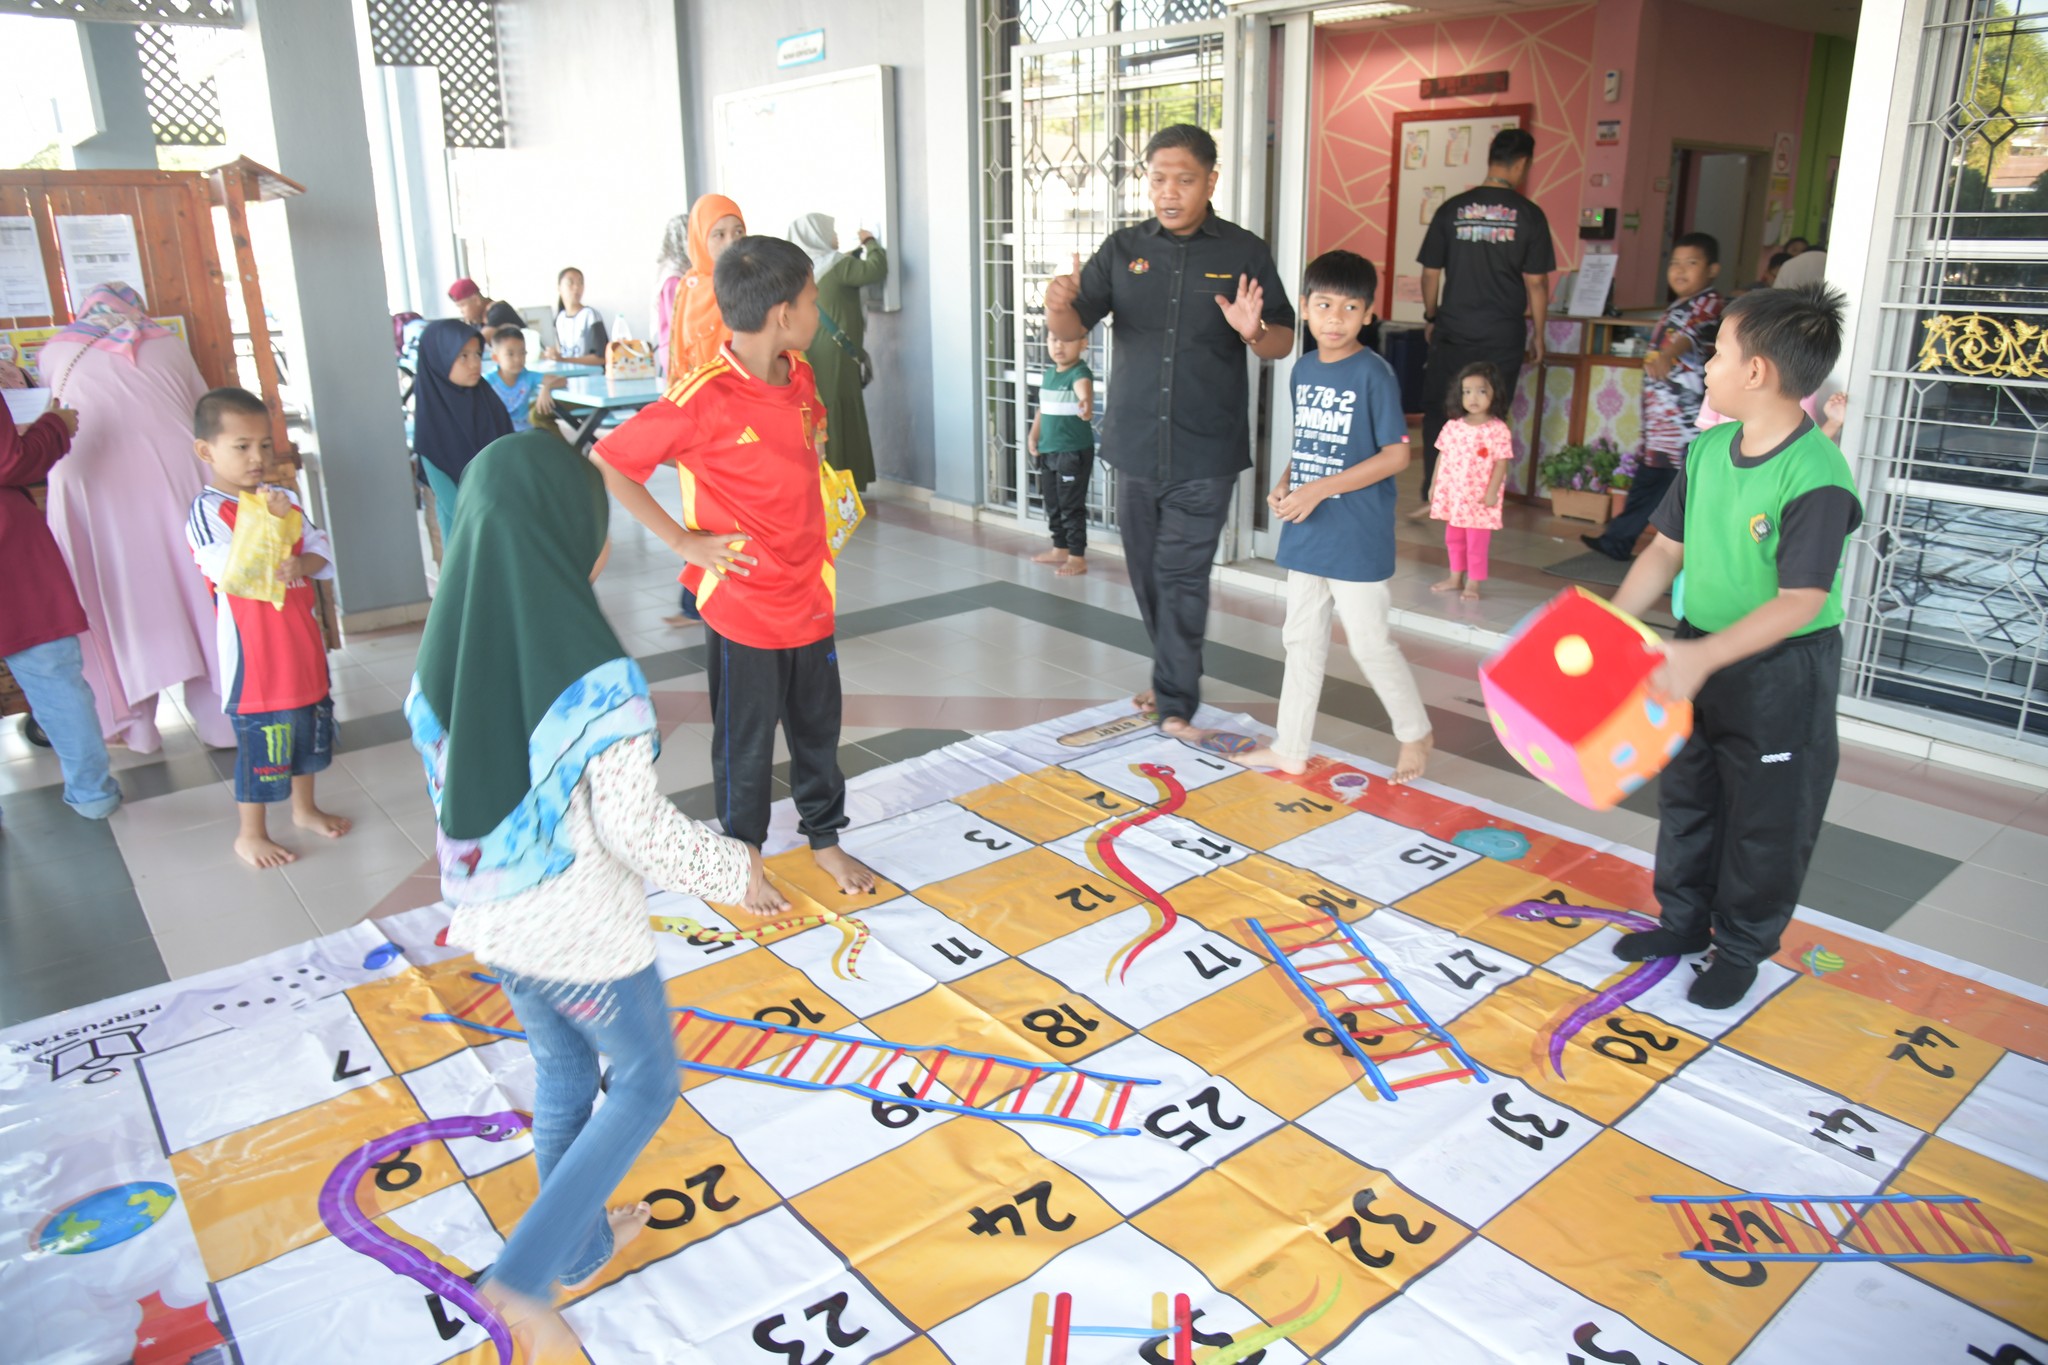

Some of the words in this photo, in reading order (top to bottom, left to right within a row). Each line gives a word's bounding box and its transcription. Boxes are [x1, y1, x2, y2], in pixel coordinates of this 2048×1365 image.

[1097, 721, 1137, 738] START
[1197, 758, 1225, 771] 1
[1084, 791, 1120, 811] 2
[1275, 795, 1333, 815] 14
[965, 829, 1011, 851] 3
[1171, 837, 1232, 861] 13
[1400, 842, 1458, 871] 15
[1055, 883, 1116, 912] 12
[1299, 889, 1358, 915] 16
[931, 936, 983, 966] 11
[1183, 943, 1242, 980] 17
[1435, 947, 1500, 991] 27
[752, 998, 826, 1033] 10
[1021, 1002, 1101, 1048] 18
[1592, 1016, 1680, 1066] 30
[1888, 1025, 1961, 1080] 42
[333, 1050, 371, 1082] 7
[871, 1083, 936, 1130] 19
[1143, 1087, 1246, 1151] 25
[1487, 1092, 1570, 1152] 31
[1808, 1107, 1877, 1161] 41
[647, 1164, 740, 1231] 20
[966, 1181, 1076, 1237] 24
[1324, 1187, 1437, 1270] 32
[1698, 1209, 1786, 1288] 40
[752, 1291, 870, 1365] 23
